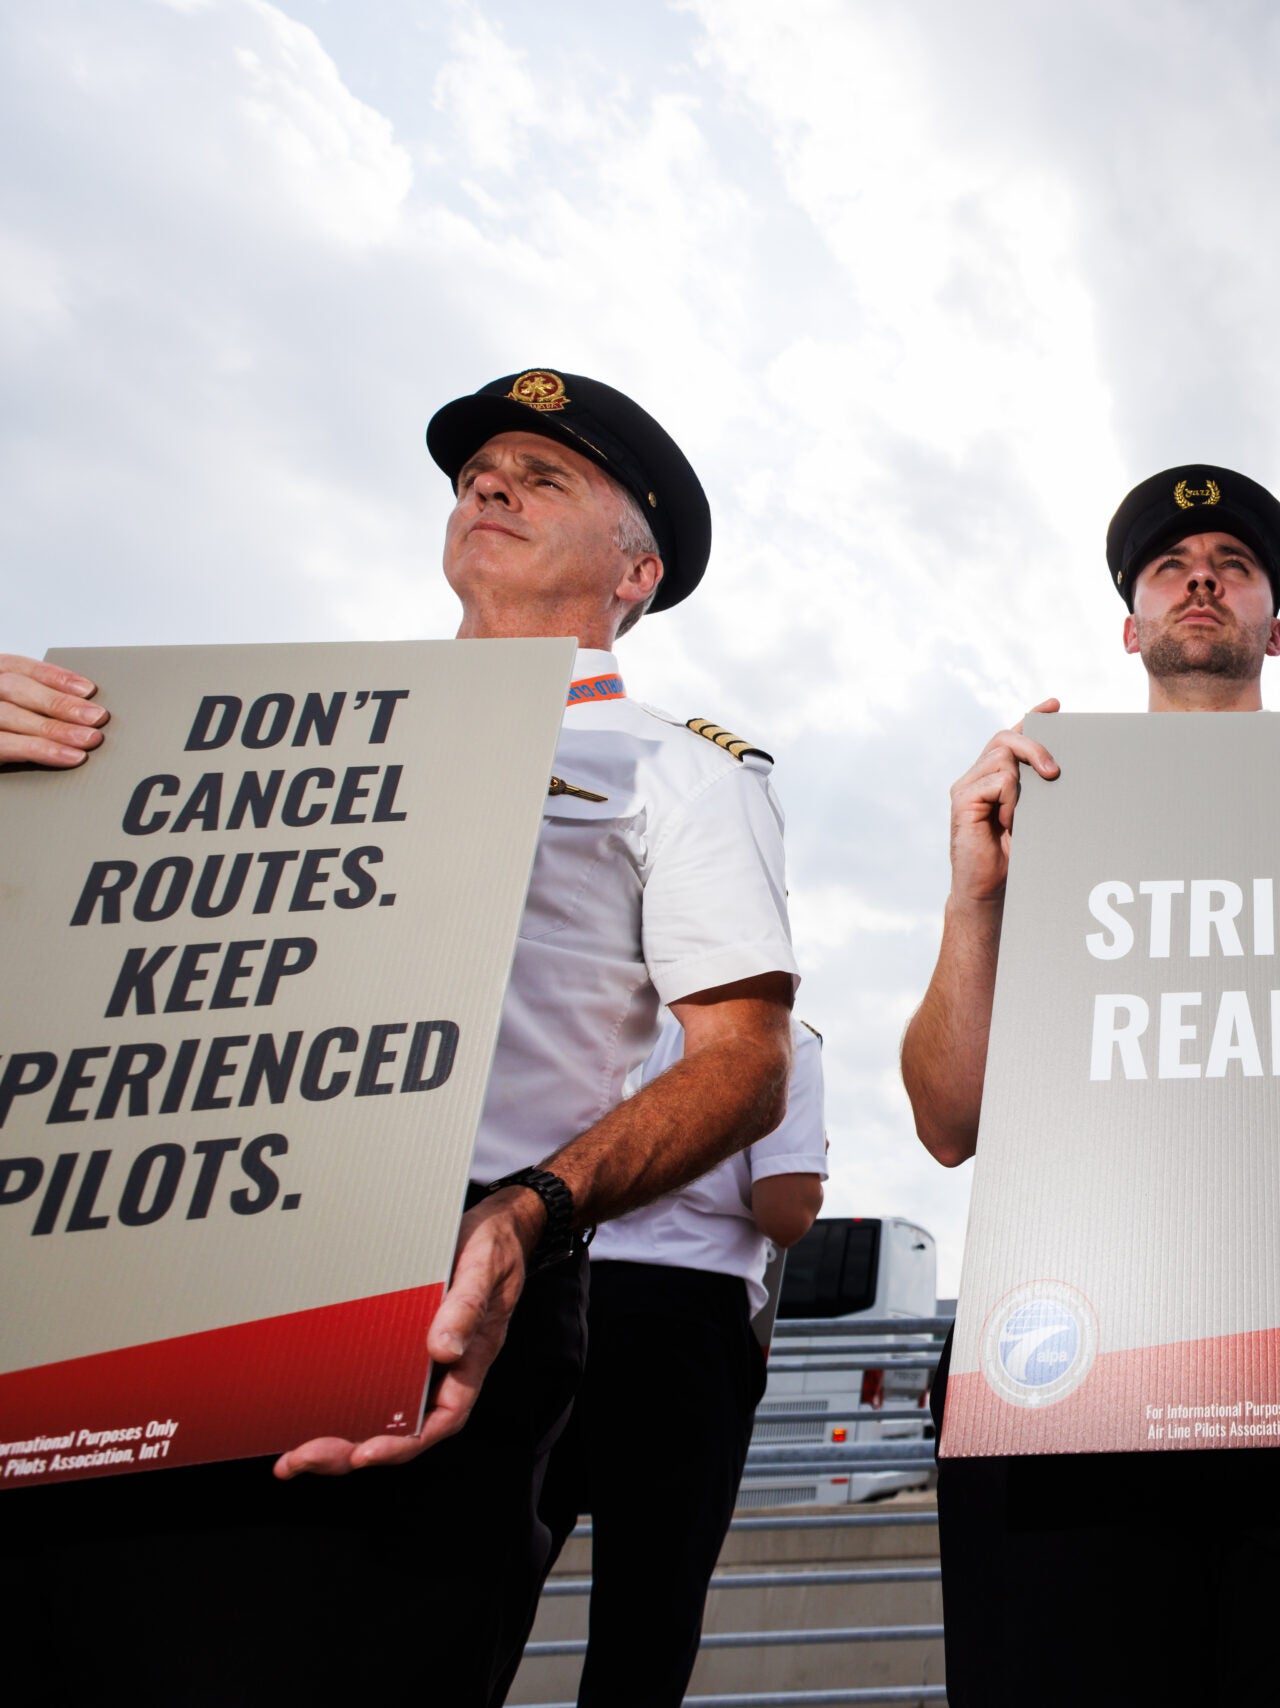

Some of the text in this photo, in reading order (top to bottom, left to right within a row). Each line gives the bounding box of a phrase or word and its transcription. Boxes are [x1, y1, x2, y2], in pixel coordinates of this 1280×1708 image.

[184, 689, 410, 751] DON'T
[122, 764, 408, 836] CANCEL
[69, 845, 397, 926] ROUTES.
[104, 936, 318, 1018] KEEP
[0, 1020, 459, 1129] PERIENCED
[0, 1132, 302, 1236] PILOTS.
[1037, 1349, 1067, 1365] alpa
[76, 1425, 143, 1447] Purposes
[145, 1419, 179, 1438] Only
[1146, 1404, 1163, 1420] For
[1167, 1402, 1242, 1420] Informational
[1148, 1424, 1164, 1440] Air
[1167, 1423, 1190, 1439] Line
[1195, 1422, 1226, 1438] Pilots
[4, 1457, 47, 1477] Pilots
[50, 1447, 135, 1471] Association,
